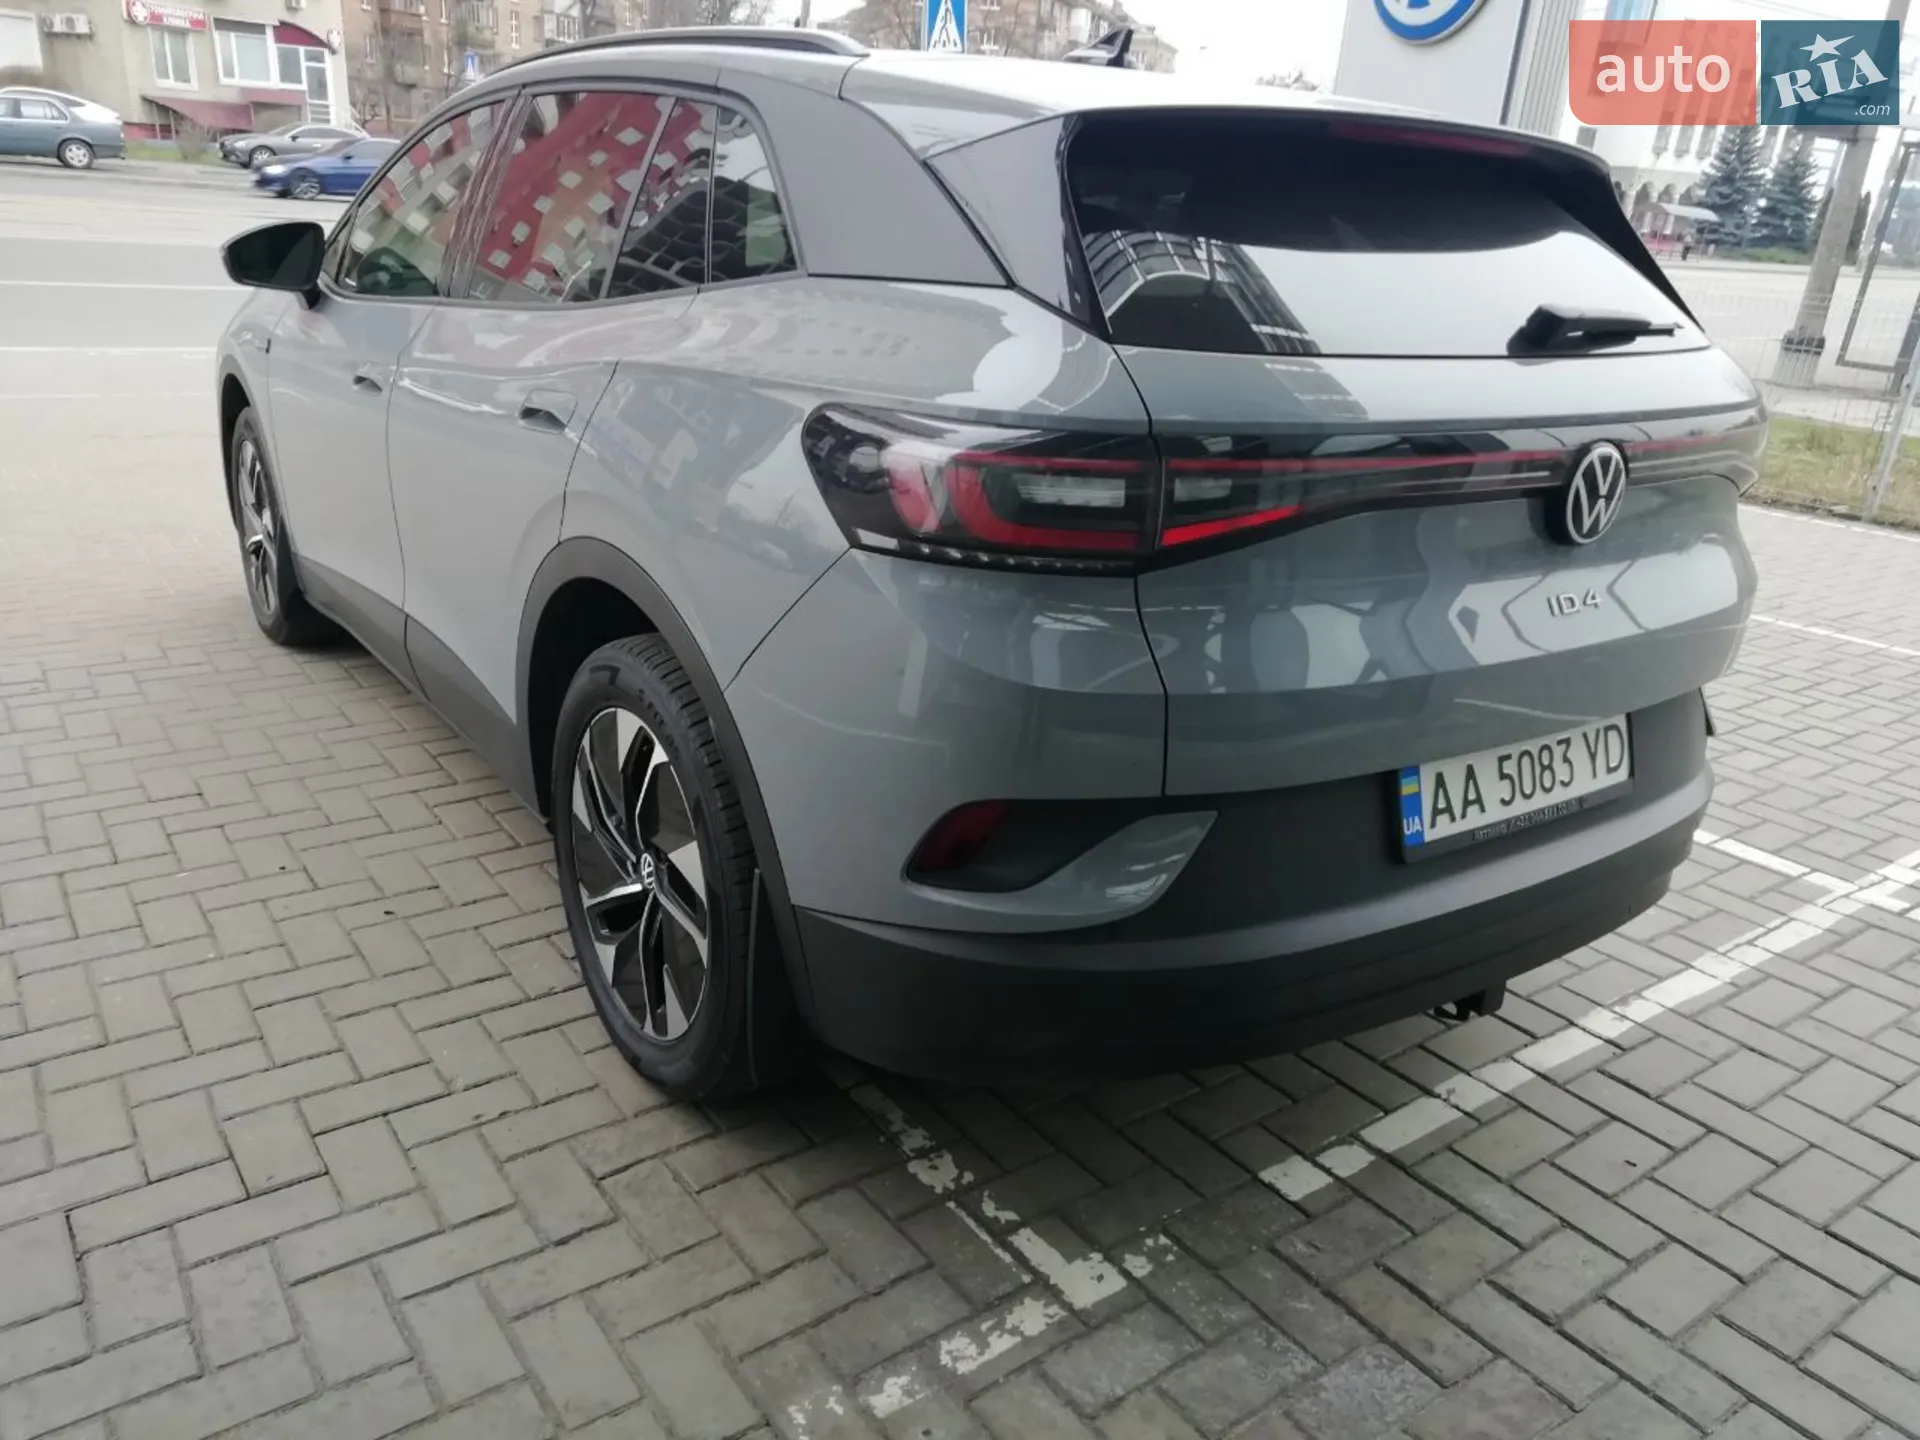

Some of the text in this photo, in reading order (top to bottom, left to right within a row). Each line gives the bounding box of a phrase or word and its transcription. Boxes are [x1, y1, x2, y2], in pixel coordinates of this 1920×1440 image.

[1430, 763, 1486, 828] AA
[1498, 737, 1574, 806] 5083
[1582, 723, 1625, 779] YD
[1403, 815, 1423, 836] UA
